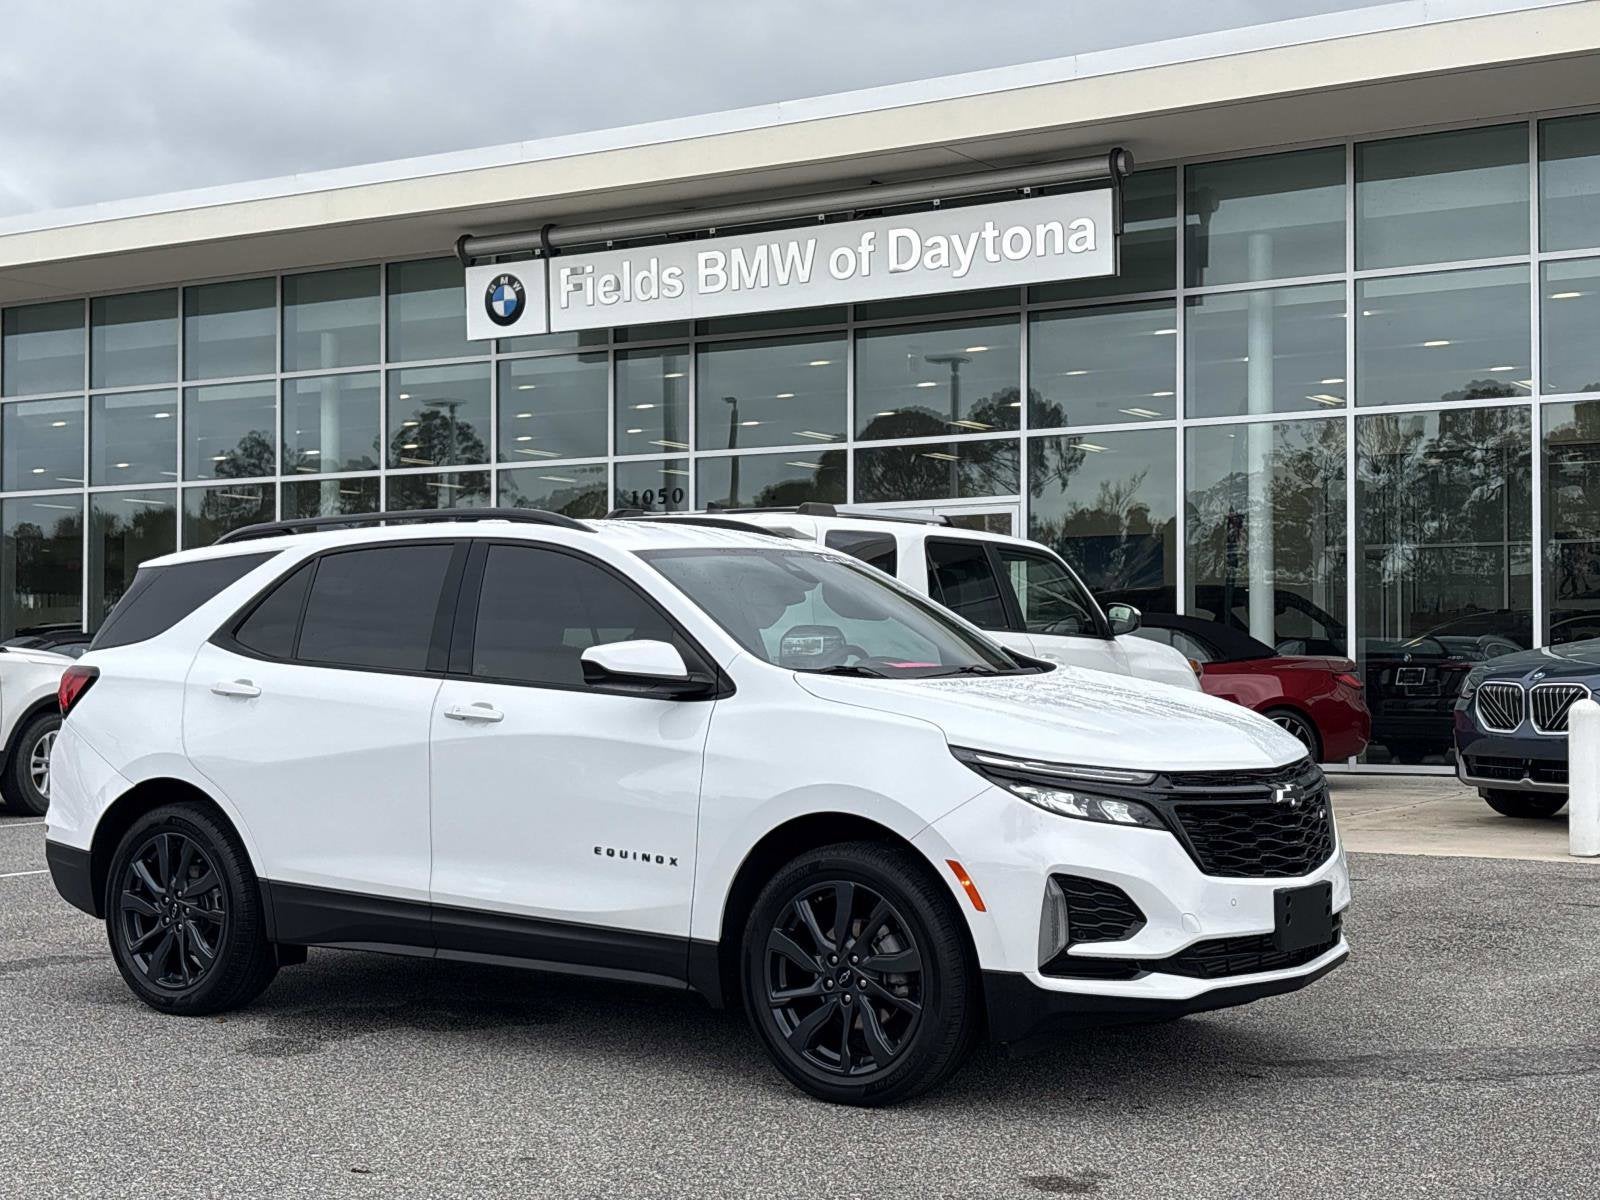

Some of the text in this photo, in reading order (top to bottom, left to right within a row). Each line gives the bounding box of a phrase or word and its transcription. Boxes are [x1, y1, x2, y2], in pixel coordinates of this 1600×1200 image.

[560, 216, 1098, 309] Fields BMW of Daytona
[488, 275, 522, 294] BMW
[630, 487, 684, 506] 1050
[593, 846, 679, 867] EQUINOX
